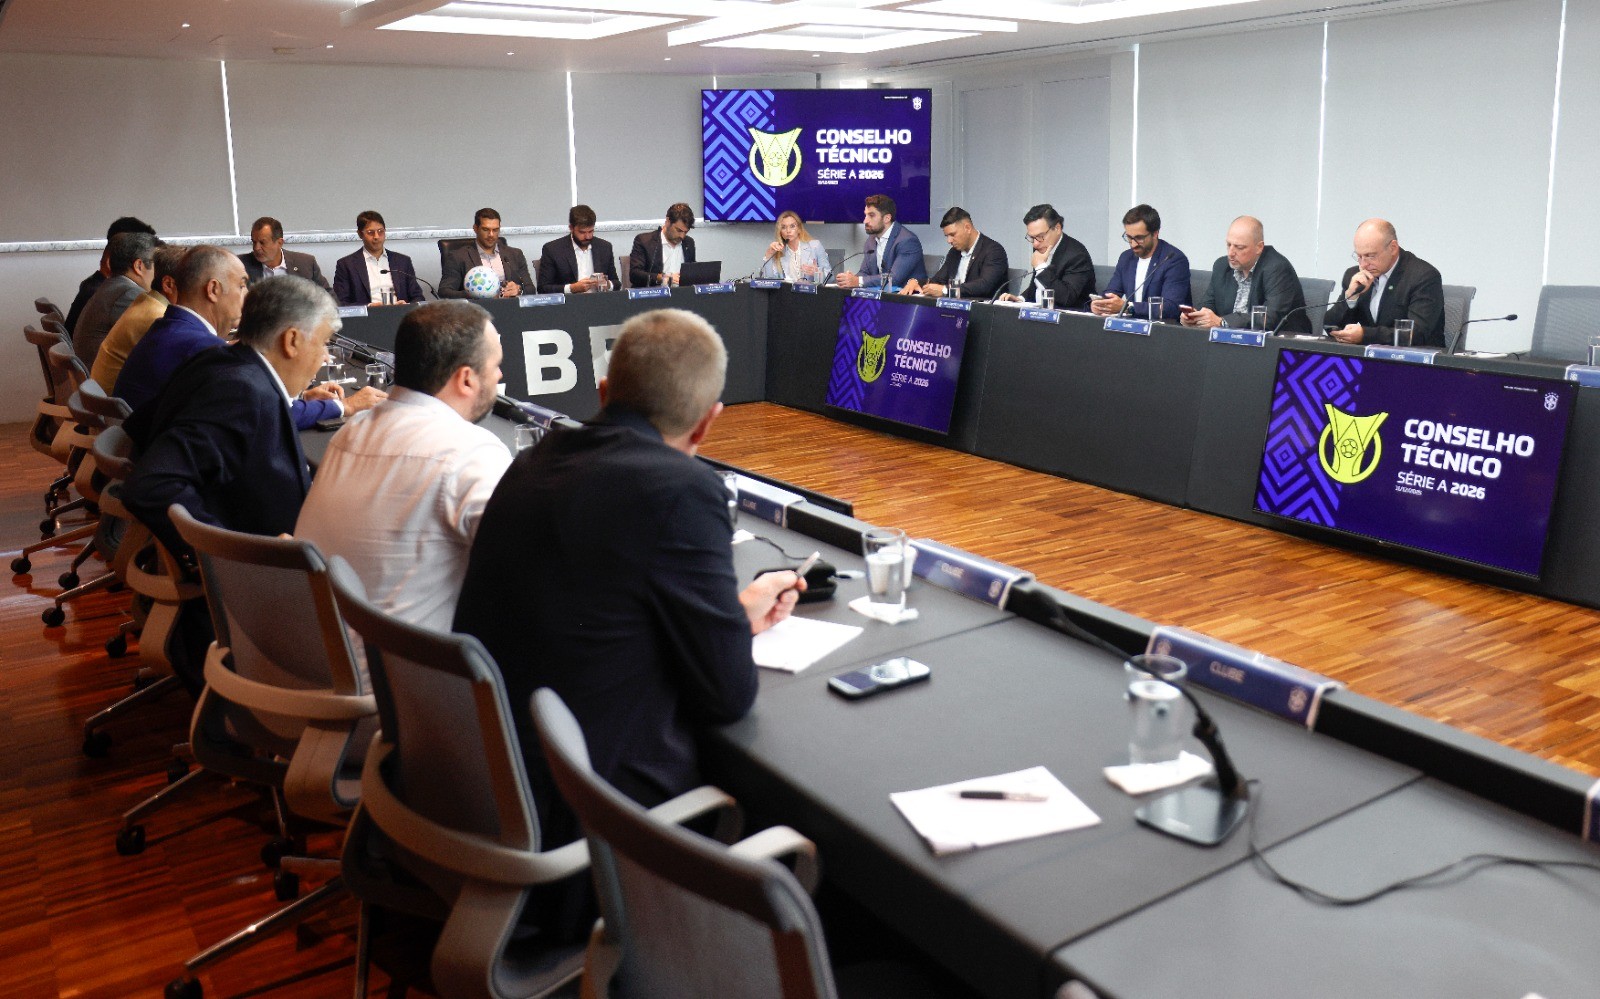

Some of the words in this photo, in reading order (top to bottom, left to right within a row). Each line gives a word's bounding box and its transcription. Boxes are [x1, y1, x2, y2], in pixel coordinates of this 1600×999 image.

[816, 128, 912, 145] CONSELHO
[816, 145, 893, 164] TÉCNICO
[817, 168, 847, 180] SÉRIE
[848, 169, 857, 180] A
[858, 169, 885, 180] 2026
[896, 338, 952, 358] CONSELHO
[894, 353, 938, 374] TÉCNICO
[891, 372, 908, 383] SÉRIE
[908, 376, 914, 384] A
[1404, 418, 1536, 457] CONSELHO
[1401, 442, 1503, 479] TÉCNICO
[1397, 470, 1436, 490] SÉRIE
[1436, 479, 1448, 493] A
[1450, 482, 1486, 500] 2026
